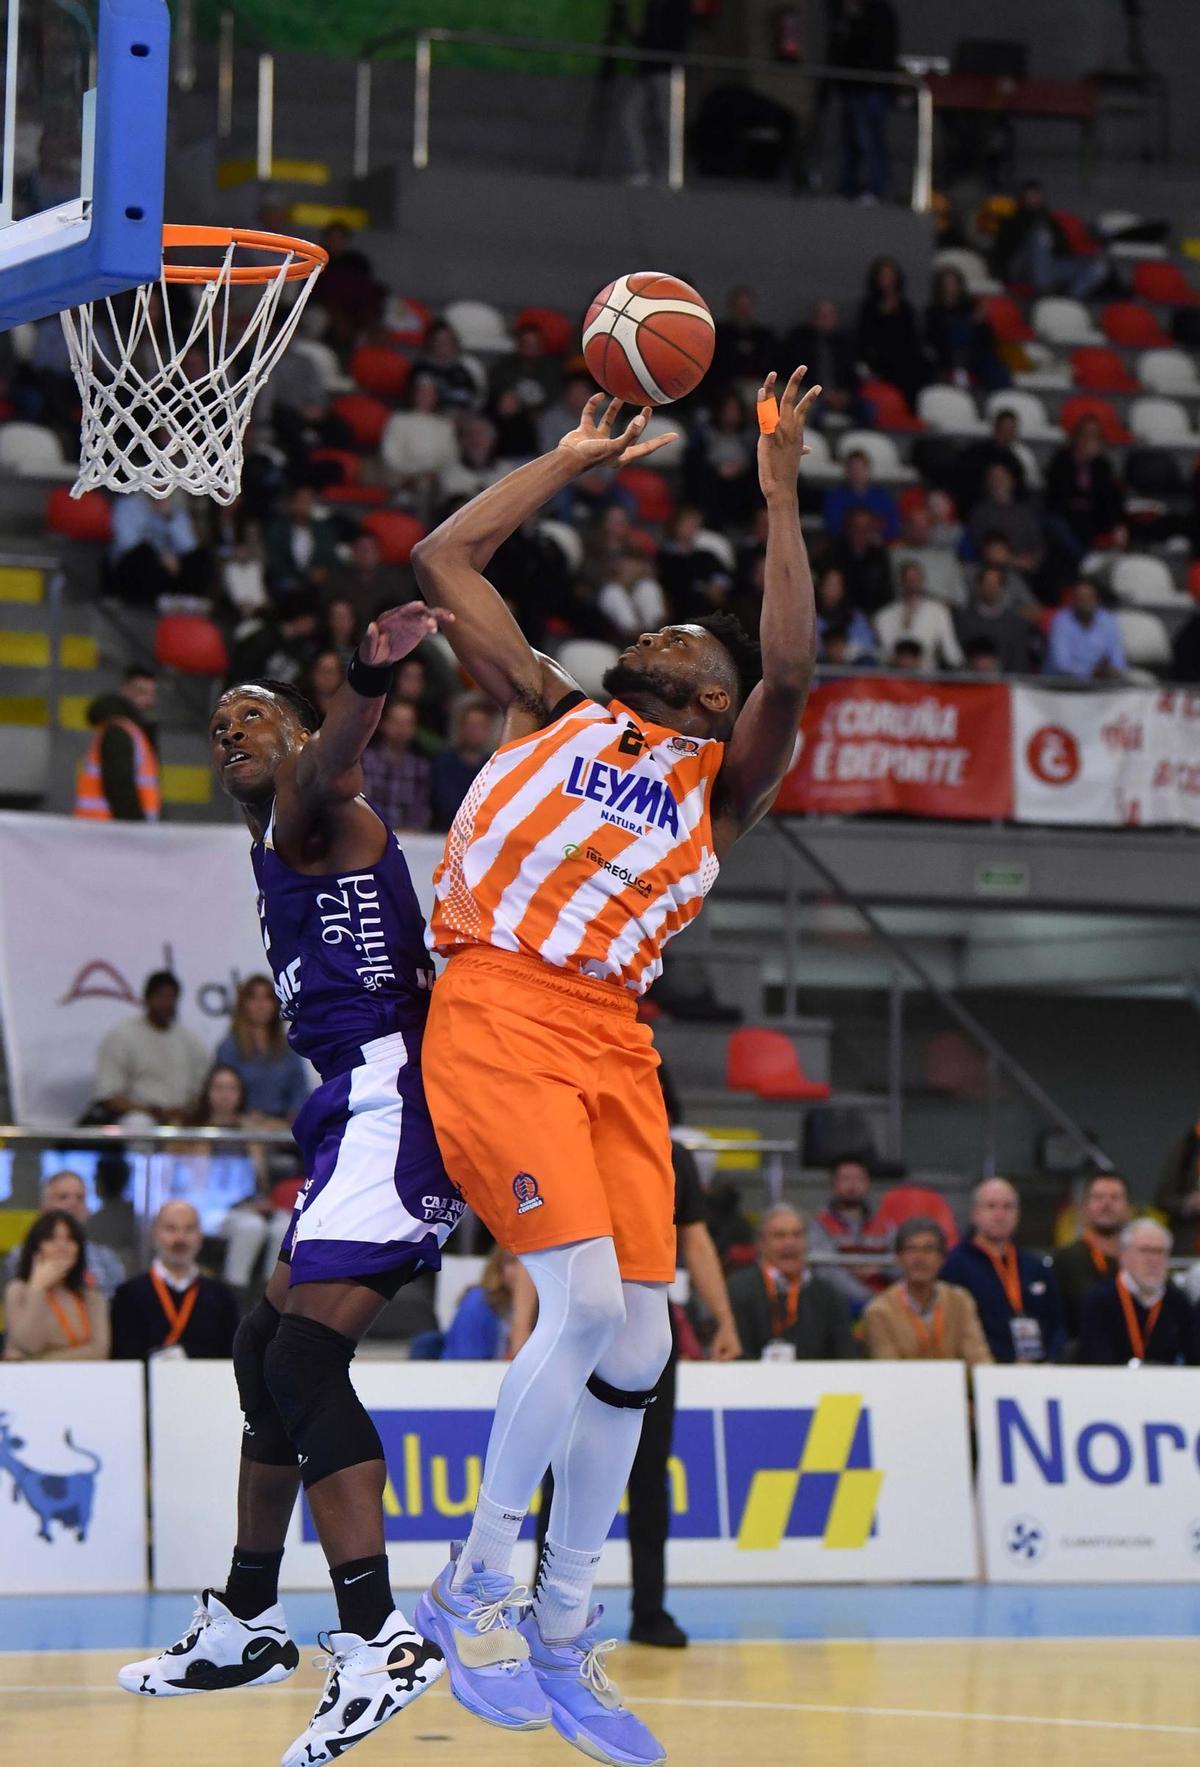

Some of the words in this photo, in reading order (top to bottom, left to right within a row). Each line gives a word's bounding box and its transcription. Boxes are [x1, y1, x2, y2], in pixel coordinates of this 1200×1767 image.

[835, 740, 970, 786] DEPORTE
[565, 755, 679, 840] LEYMA
[600, 809, 644, 836] NATURA
[586, 850, 653, 894] IBEREÓLICA
[316, 889, 355, 945] 912
[996, 1397, 1200, 1487] Nor
